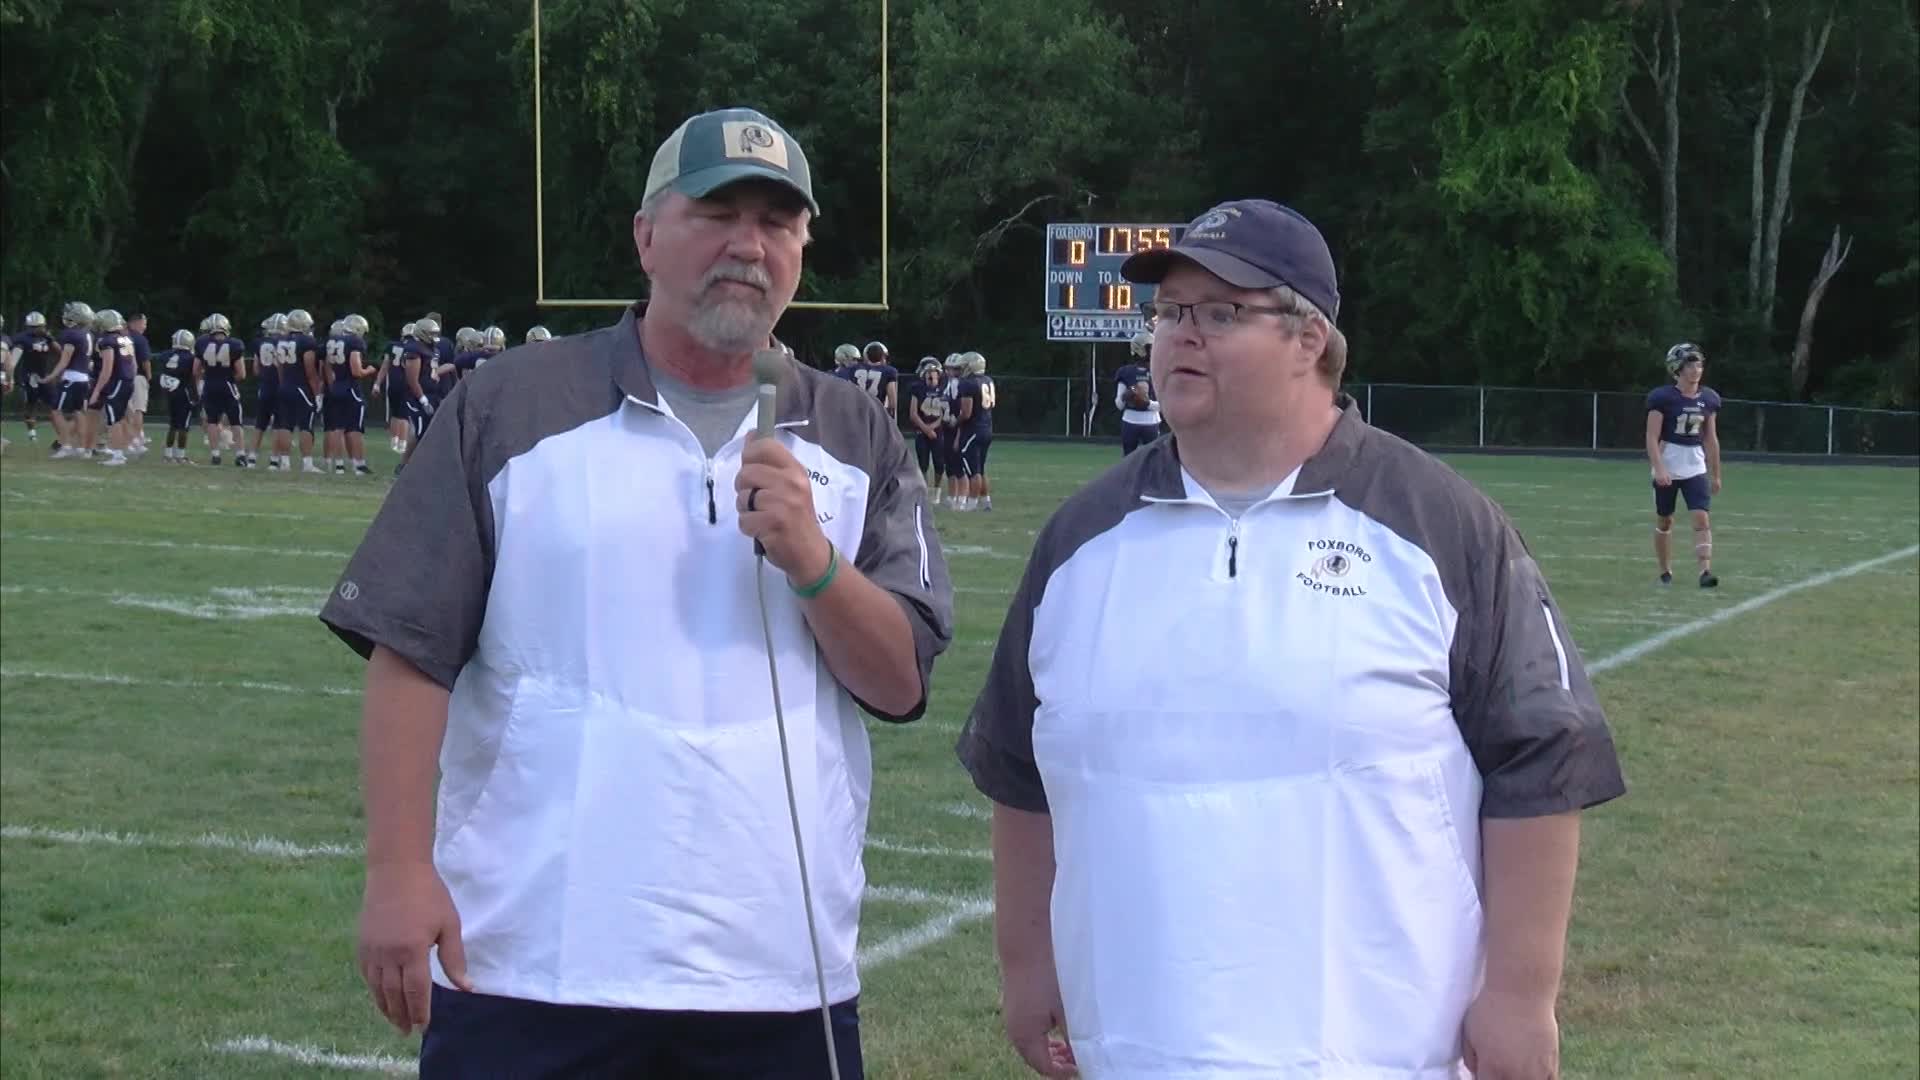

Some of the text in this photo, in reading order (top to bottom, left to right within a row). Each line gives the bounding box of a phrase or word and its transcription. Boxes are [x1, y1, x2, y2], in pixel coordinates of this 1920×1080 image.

[1050, 227, 1093, 239] FOXBORO
[1071, 240, 1085, 265] 0
[1050, 271, 1083, 284] DOWN
[1098, 271, 1132, 284] TO G
[1069, 285, 1074, 309] 1
[1108, 285, 1131, 309] 10
[1067, 319, 1097, 329] JACK
[203, 343, 231, 367] 44
[1674, 413, 1705, 435] 17
[1307, 539, 1372, 563] FOXBORO
[1296, 572, 1367, 596] FOOTBALL
